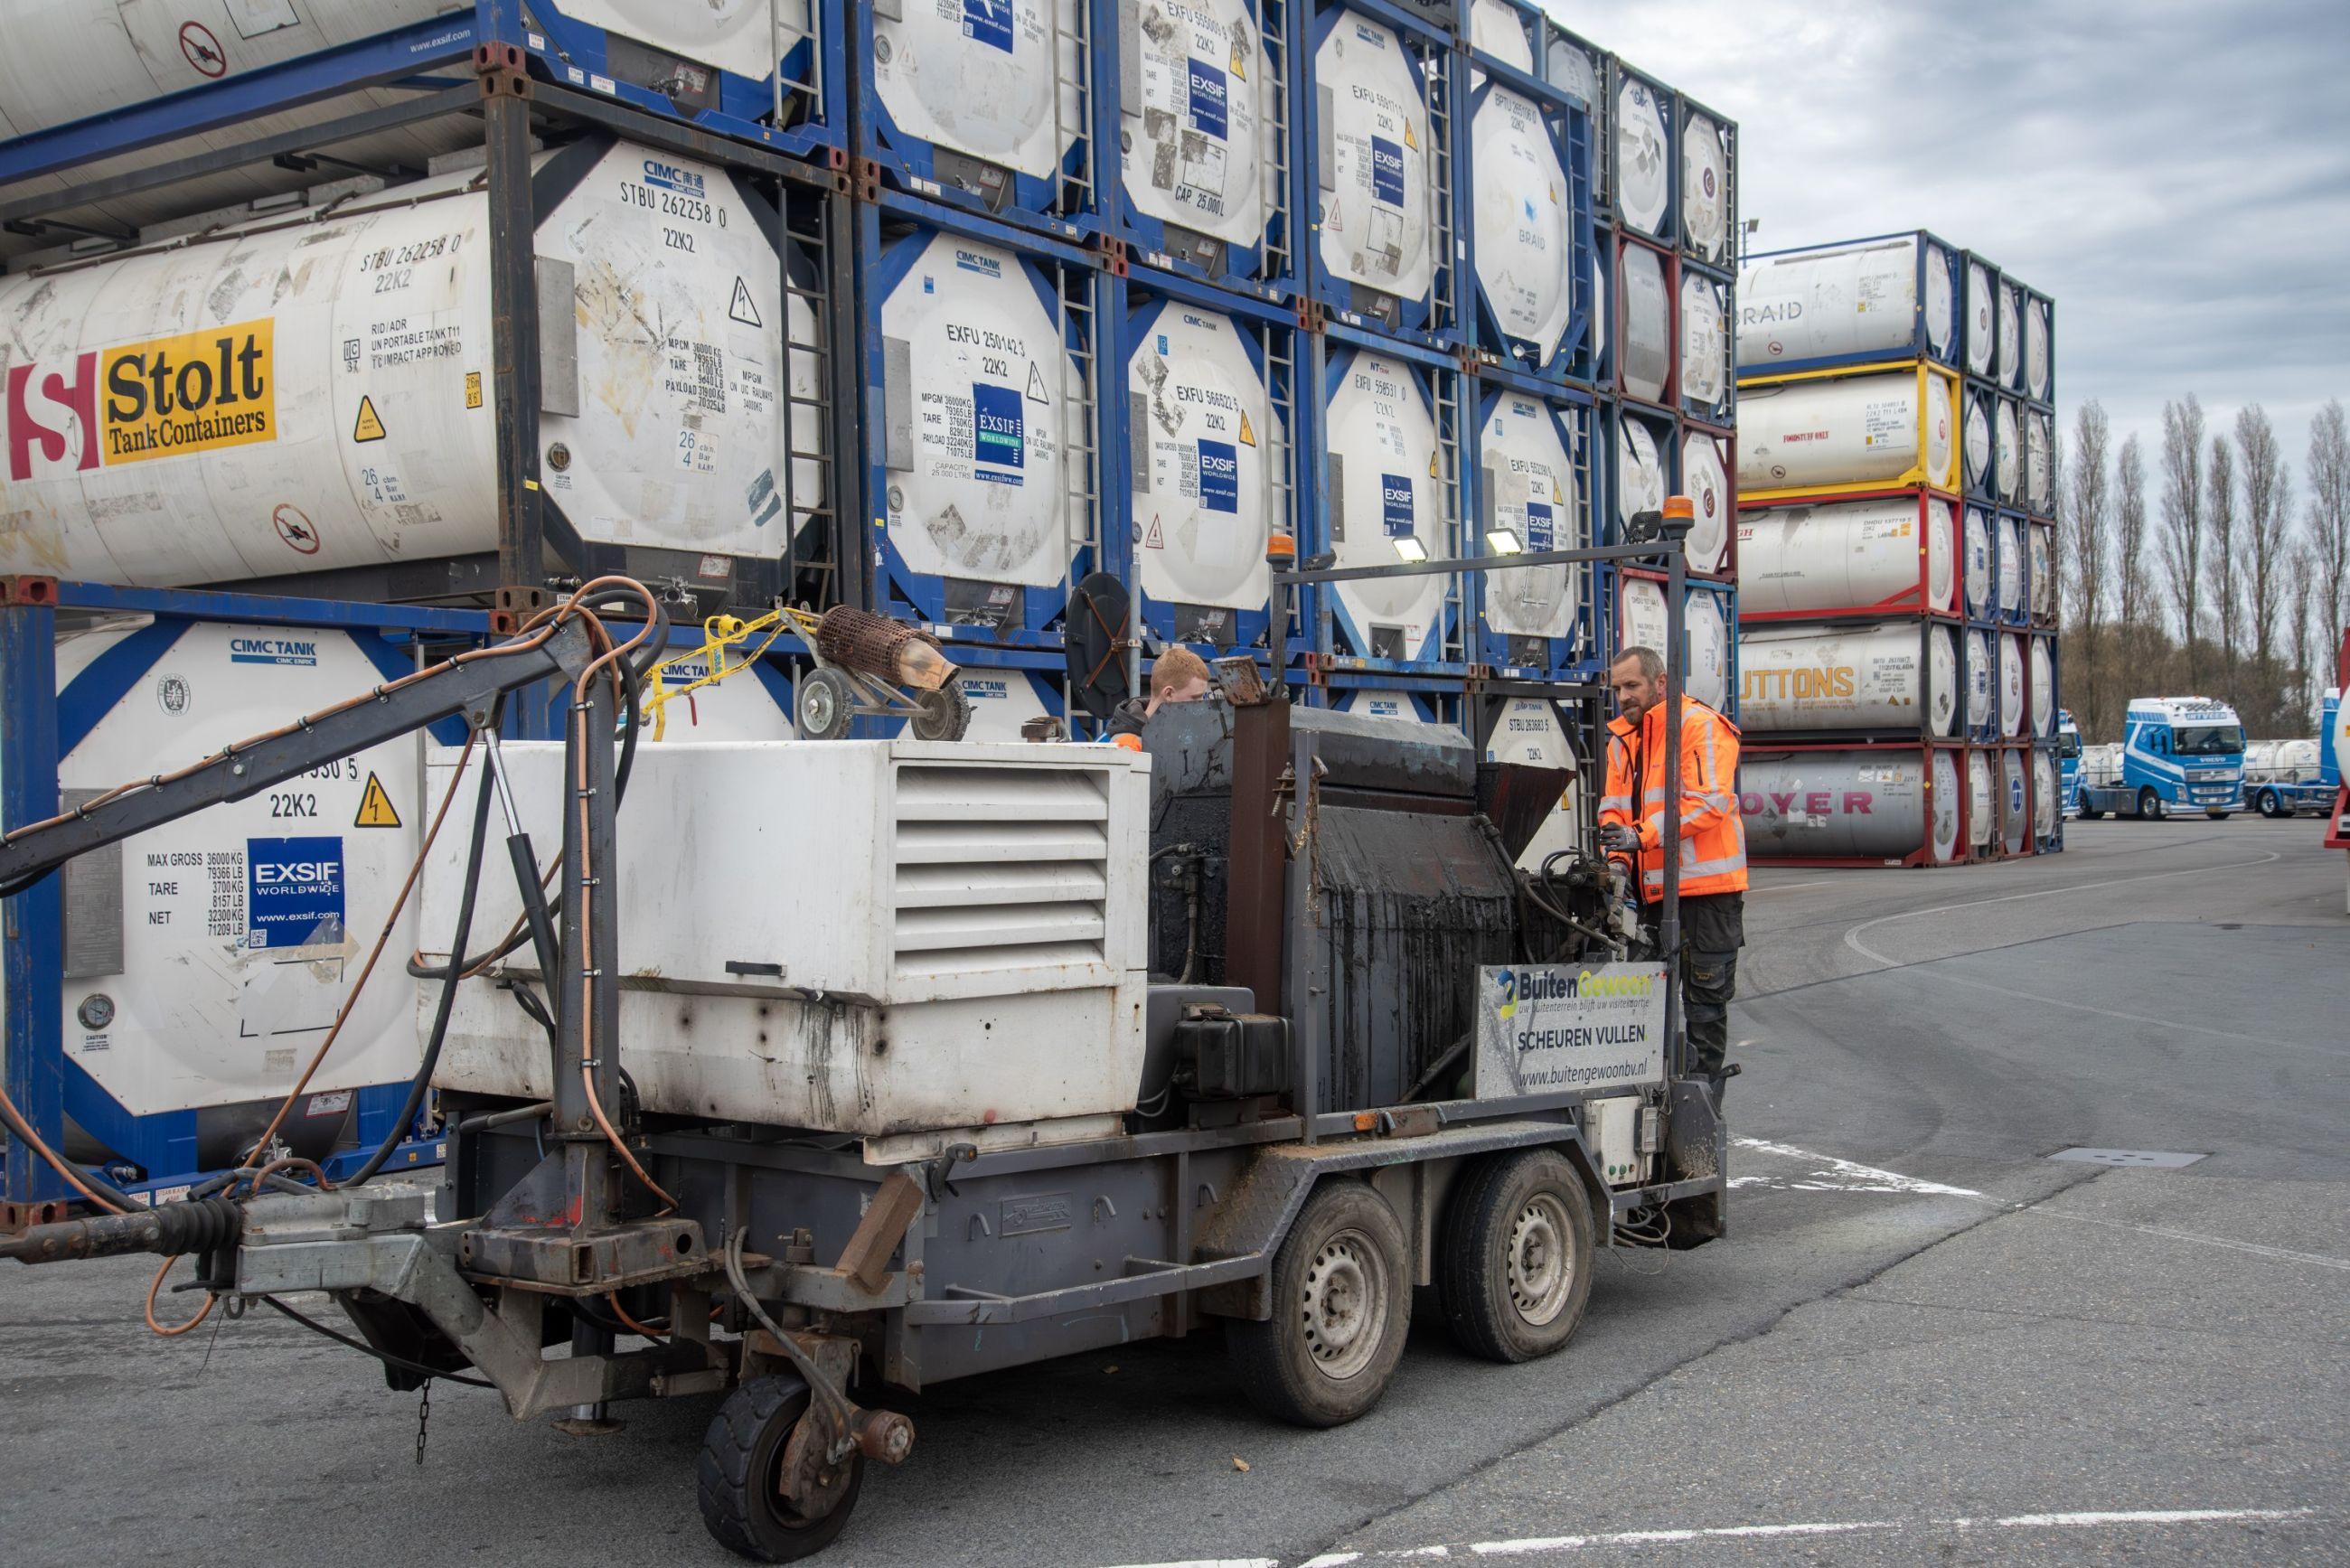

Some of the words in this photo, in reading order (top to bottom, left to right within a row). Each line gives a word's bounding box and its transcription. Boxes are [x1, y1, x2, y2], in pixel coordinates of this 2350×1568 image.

[410, 30, 470, 52] www.exsif.com
[1196, 33, 1216, 55] 22K2
[1191, 74, 1226, 99] EXSIF
[1352, 85, 1375, 103] EXFU
[1192, 88, 1227, 108] WORLDWIDE
[1375, 150, 1403, 170] EXSIF
[644, 160, 682, 183] CIMC
[682, 171, 705, 189] 南通
[1176, 185, 1192, 204] CAP.
[621, 182, 656, 209] STBU
[662, 192, 711, 224] 262258
[719, 208, 727, 228] 0
[663, 228, 695, 253] 22K2
[1519, 229, 1546, 250] BRAID
[361, 249, 395, 272] STBU
[396, 235, 447, 266] 262258
[452, 234, 462, 253] 0
[955, 249, 978, 265] CIMC
[979, 255, 1001, 272] TANK
[374, 268, 412, 294] 22K2
[1735, 301, 1802, 326] RAID
[1183, 314, 1203, 327] CIMC
[1202, 321, 1217, 332] TANK
[371, 340, 383, 352] UN
[383, 331, 424, 349] PORTABLE
[425, 327, 447, 342] TANK
[447, 325, 461, 338] T11
[946, 324, 980, 345] EXFU
[982, 332, 1019, 356] 250142
[384, 350, 415, 366] IMPACT
[415, 341, 463, 360] APPROVED
[670, 358, 688, 371] TARE
[982, 356, 1009, 378] 22K2
[108, 333, 265, 424] Stolt
[742, 370, 763, 384] MPGM
[666, 380, 697, 396] PAYLOAD
[922, 392, 943, 405] MPGM
[1177, 385, 1204, 402] EXFU
[1206, 390, 1233, 410] 566522
[923, 413, 942, 425] TARE
[980, 414, 1015, 435] EXSIF
[1205, 413, 1226, 431] 22K2
[109, 423, 159, 456] Tank
[159, 410, 266, 447] Containers
[680, 431, 696, 449] 26
[923, 433, 945, 446] PAYLOAD
[982, 431, 1020, 447] WORLDWIDE
[1815, 430, 1830, 441] ONLY
[682, 451, 691, 467] 4
[699, 453, 711, 462] Bar
[1201, 455, 1236, 473] EXSIF
[1510, 459, 1530, 473] EXFU
[935, 462, 969, 472] CAPACITY
[954, 471, 971, 480] LTRS
[1202, 470, 1236, 482] WORLDWIDE
[362, 467, 379, 486] 26
[375, 486, 384, 502] 4
[1385, 489, 1412, 502] EXSIF
[1529, 516, 1552, 529] EXSIF
[230, 638, 274, 654] CIMC
[275, 640, 317, 656] TANK
[661, 664, 691, 676] CIMC
[963, 680, 984, 690] CIMC
[984, 681, 1007, 691] TANK
[1369, 701, 1384, 709] CIMC
[1384, 701, 1398, 709] TANK
[1509, 718, 1525, 731] STBU
[270, 793, 318, 818] 22K2
[147, 853, 169, 868] MAX
[170, 851, 203, 866] GROSS
[207, 867, 232, 882] 79366
[233, 866, 244, 881] LB
[255, 862, 340, 884] EXSIF
[148, 881, 179, 897] TARE
[257, 886, 341, 897] WORLDWIDE
[212, 894, 231, 908] 8157
[232, 894, 244, 908] LB
[148, 911, 172, 925] NET
[256, 910, 341, 923] www.exsif.com
[207, 923, 232, 937] 71209
[232, 922, 244, 936] LB
[1519, 969, 1650, 1000] BuitenGewoon
[1518, 1006, 1529, 1014] uw
[1530, 999, 1577, 1013] buitenterrein
[1579, 997, 1596, 1013] blijft
[1597, 1000, 1609, 1009] uw
[1518, 1027, 1593, 1052] SCHEUREN
[1519, 1057, 1648, 1087] www.buitengewoonbv.nl
